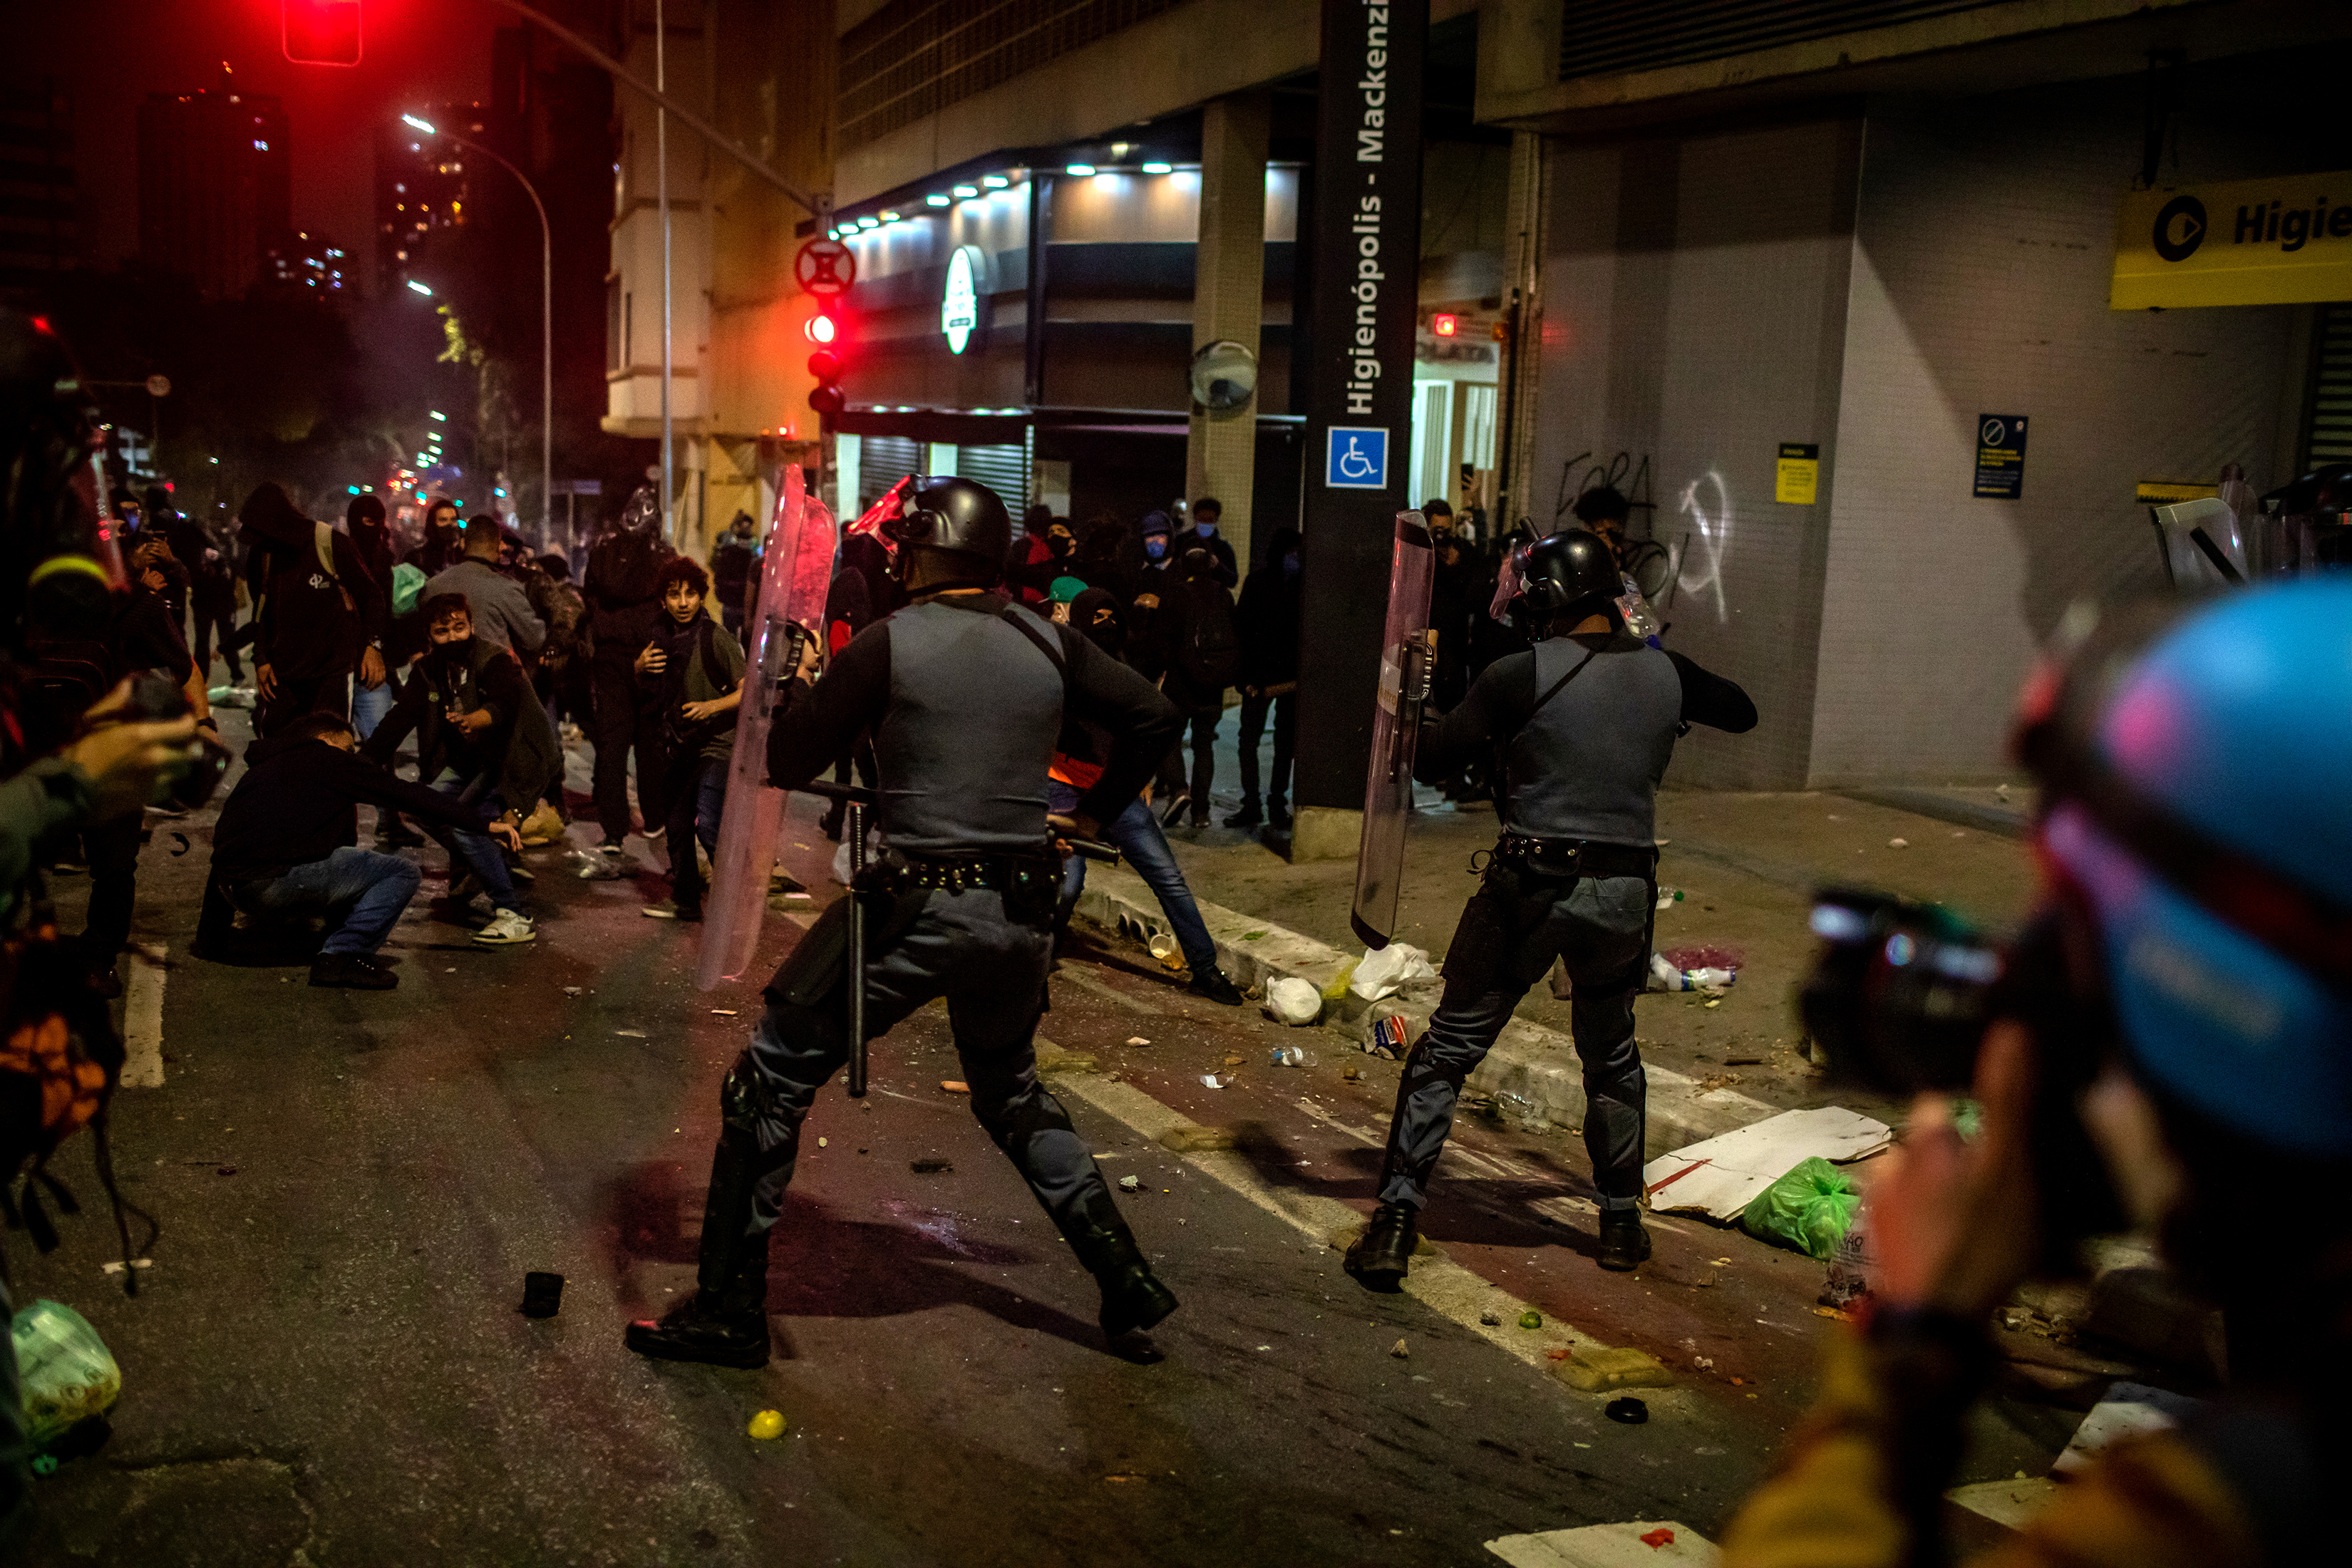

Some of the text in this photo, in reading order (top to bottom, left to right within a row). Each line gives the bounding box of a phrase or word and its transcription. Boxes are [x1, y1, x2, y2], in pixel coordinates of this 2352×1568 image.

[1346, 195, 1385, 414] Higienópolis
[1368, 172, 1376, 185] -
[2235, 197, 2352, 252] Higie
